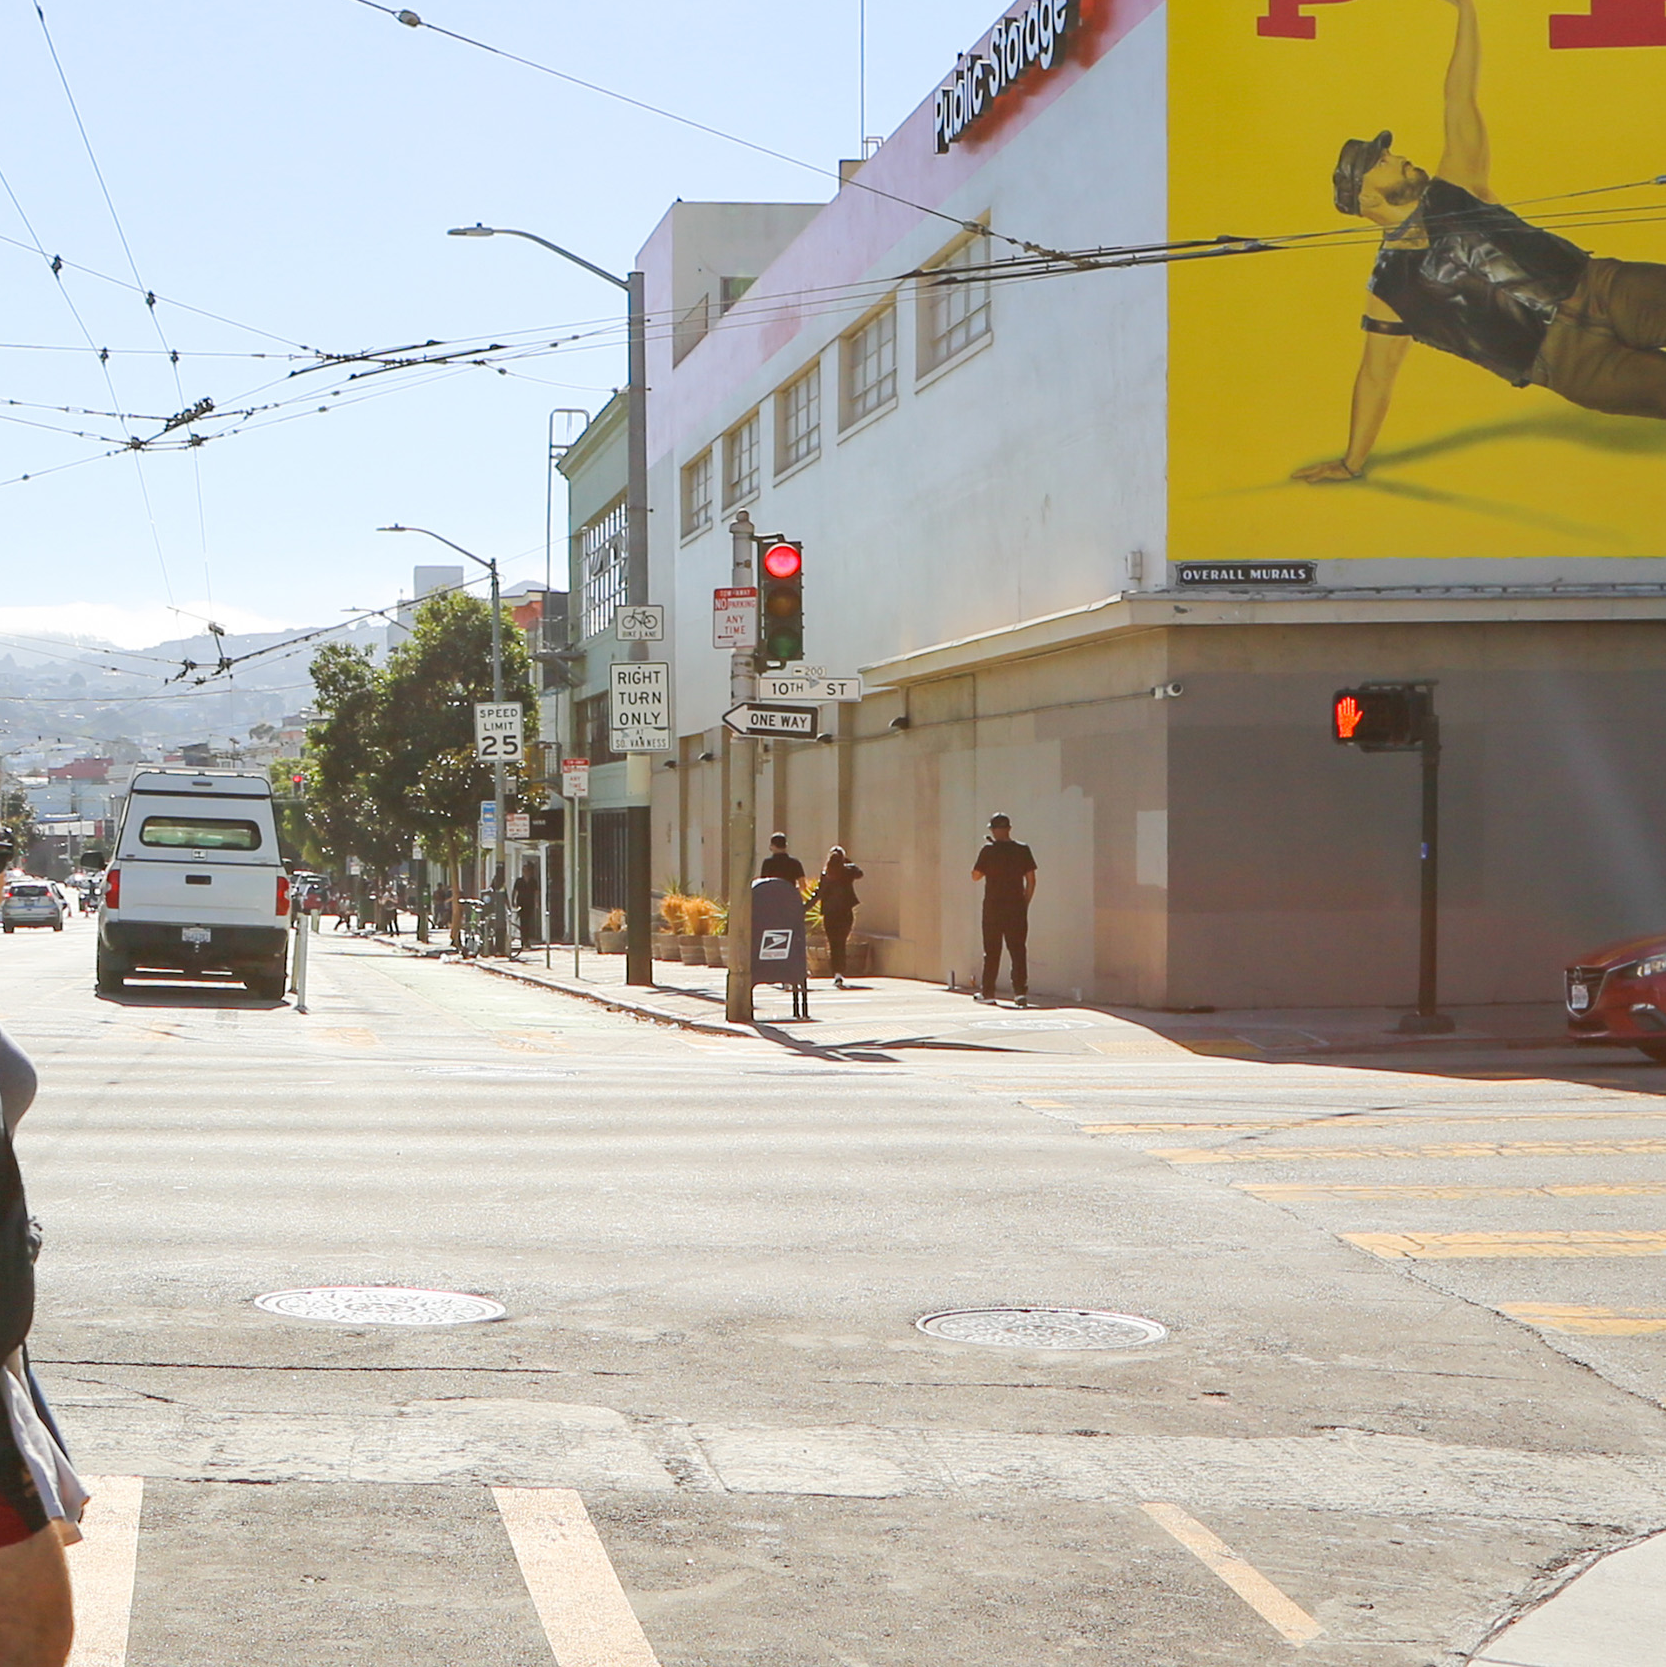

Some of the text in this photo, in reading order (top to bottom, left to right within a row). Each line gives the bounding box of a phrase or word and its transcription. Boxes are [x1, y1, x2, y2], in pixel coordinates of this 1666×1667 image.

[934, 54, 983, 154] Public
[1183, 568, 1306, 580] OVERALL MURALS
[715, 598, 727, 610] NO
[726, 615, 744, 623] ANY
[725, 625, 746, 635] TIME
[805, 667, 823, 676] 200
[618, 671, 661, 685] RIGHT
[772, 682, 847, 695] 10TH ST
[619, 692, 662, 705] TURN
[479, 709, 518, 718] SPEED
[619, 712, 661, 726] ONLY
[483, 722, 514, 731] LIMIT
[750, 713, 808, 728] ONE WAY
[481, 735, 518, 755] 25
[630, 739, 645, 748] VAN
[647, 738, 667, 748] NESS
